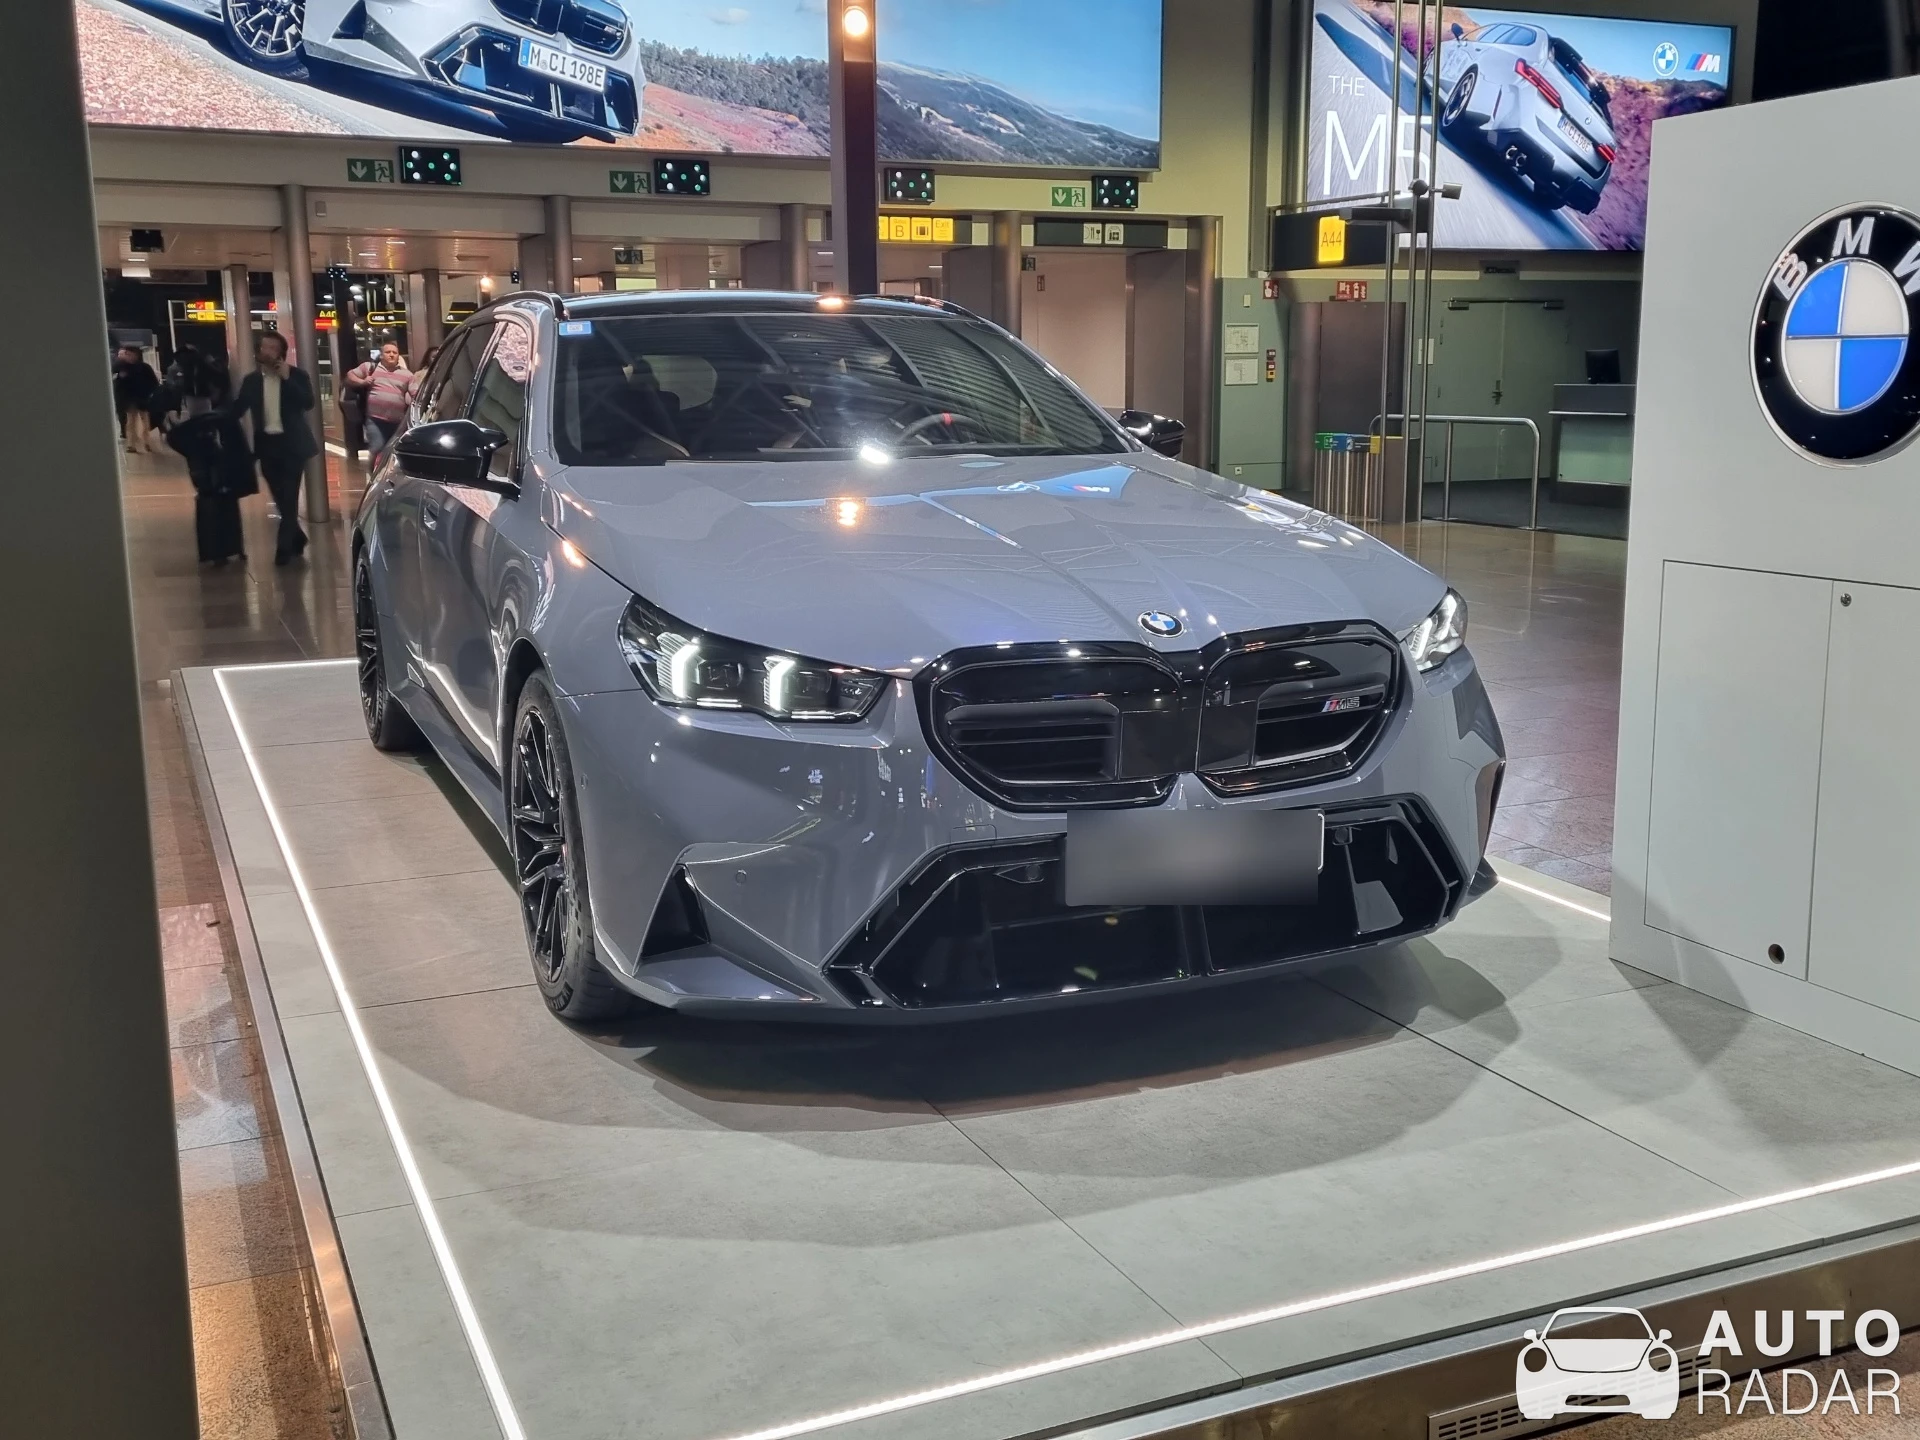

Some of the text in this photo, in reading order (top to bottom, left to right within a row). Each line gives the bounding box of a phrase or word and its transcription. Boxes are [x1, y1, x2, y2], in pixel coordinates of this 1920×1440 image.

[530, 45, 541, 67] M
[569, 60, 603, 87] 198E
[1328, 75, 1366, 97] THE
[1323, 110, 1435, 200] M5
[895, 225, 904, 238] B
[935, 219, 950, 229] Exit
[1320, 230, 1342, 248] A44
